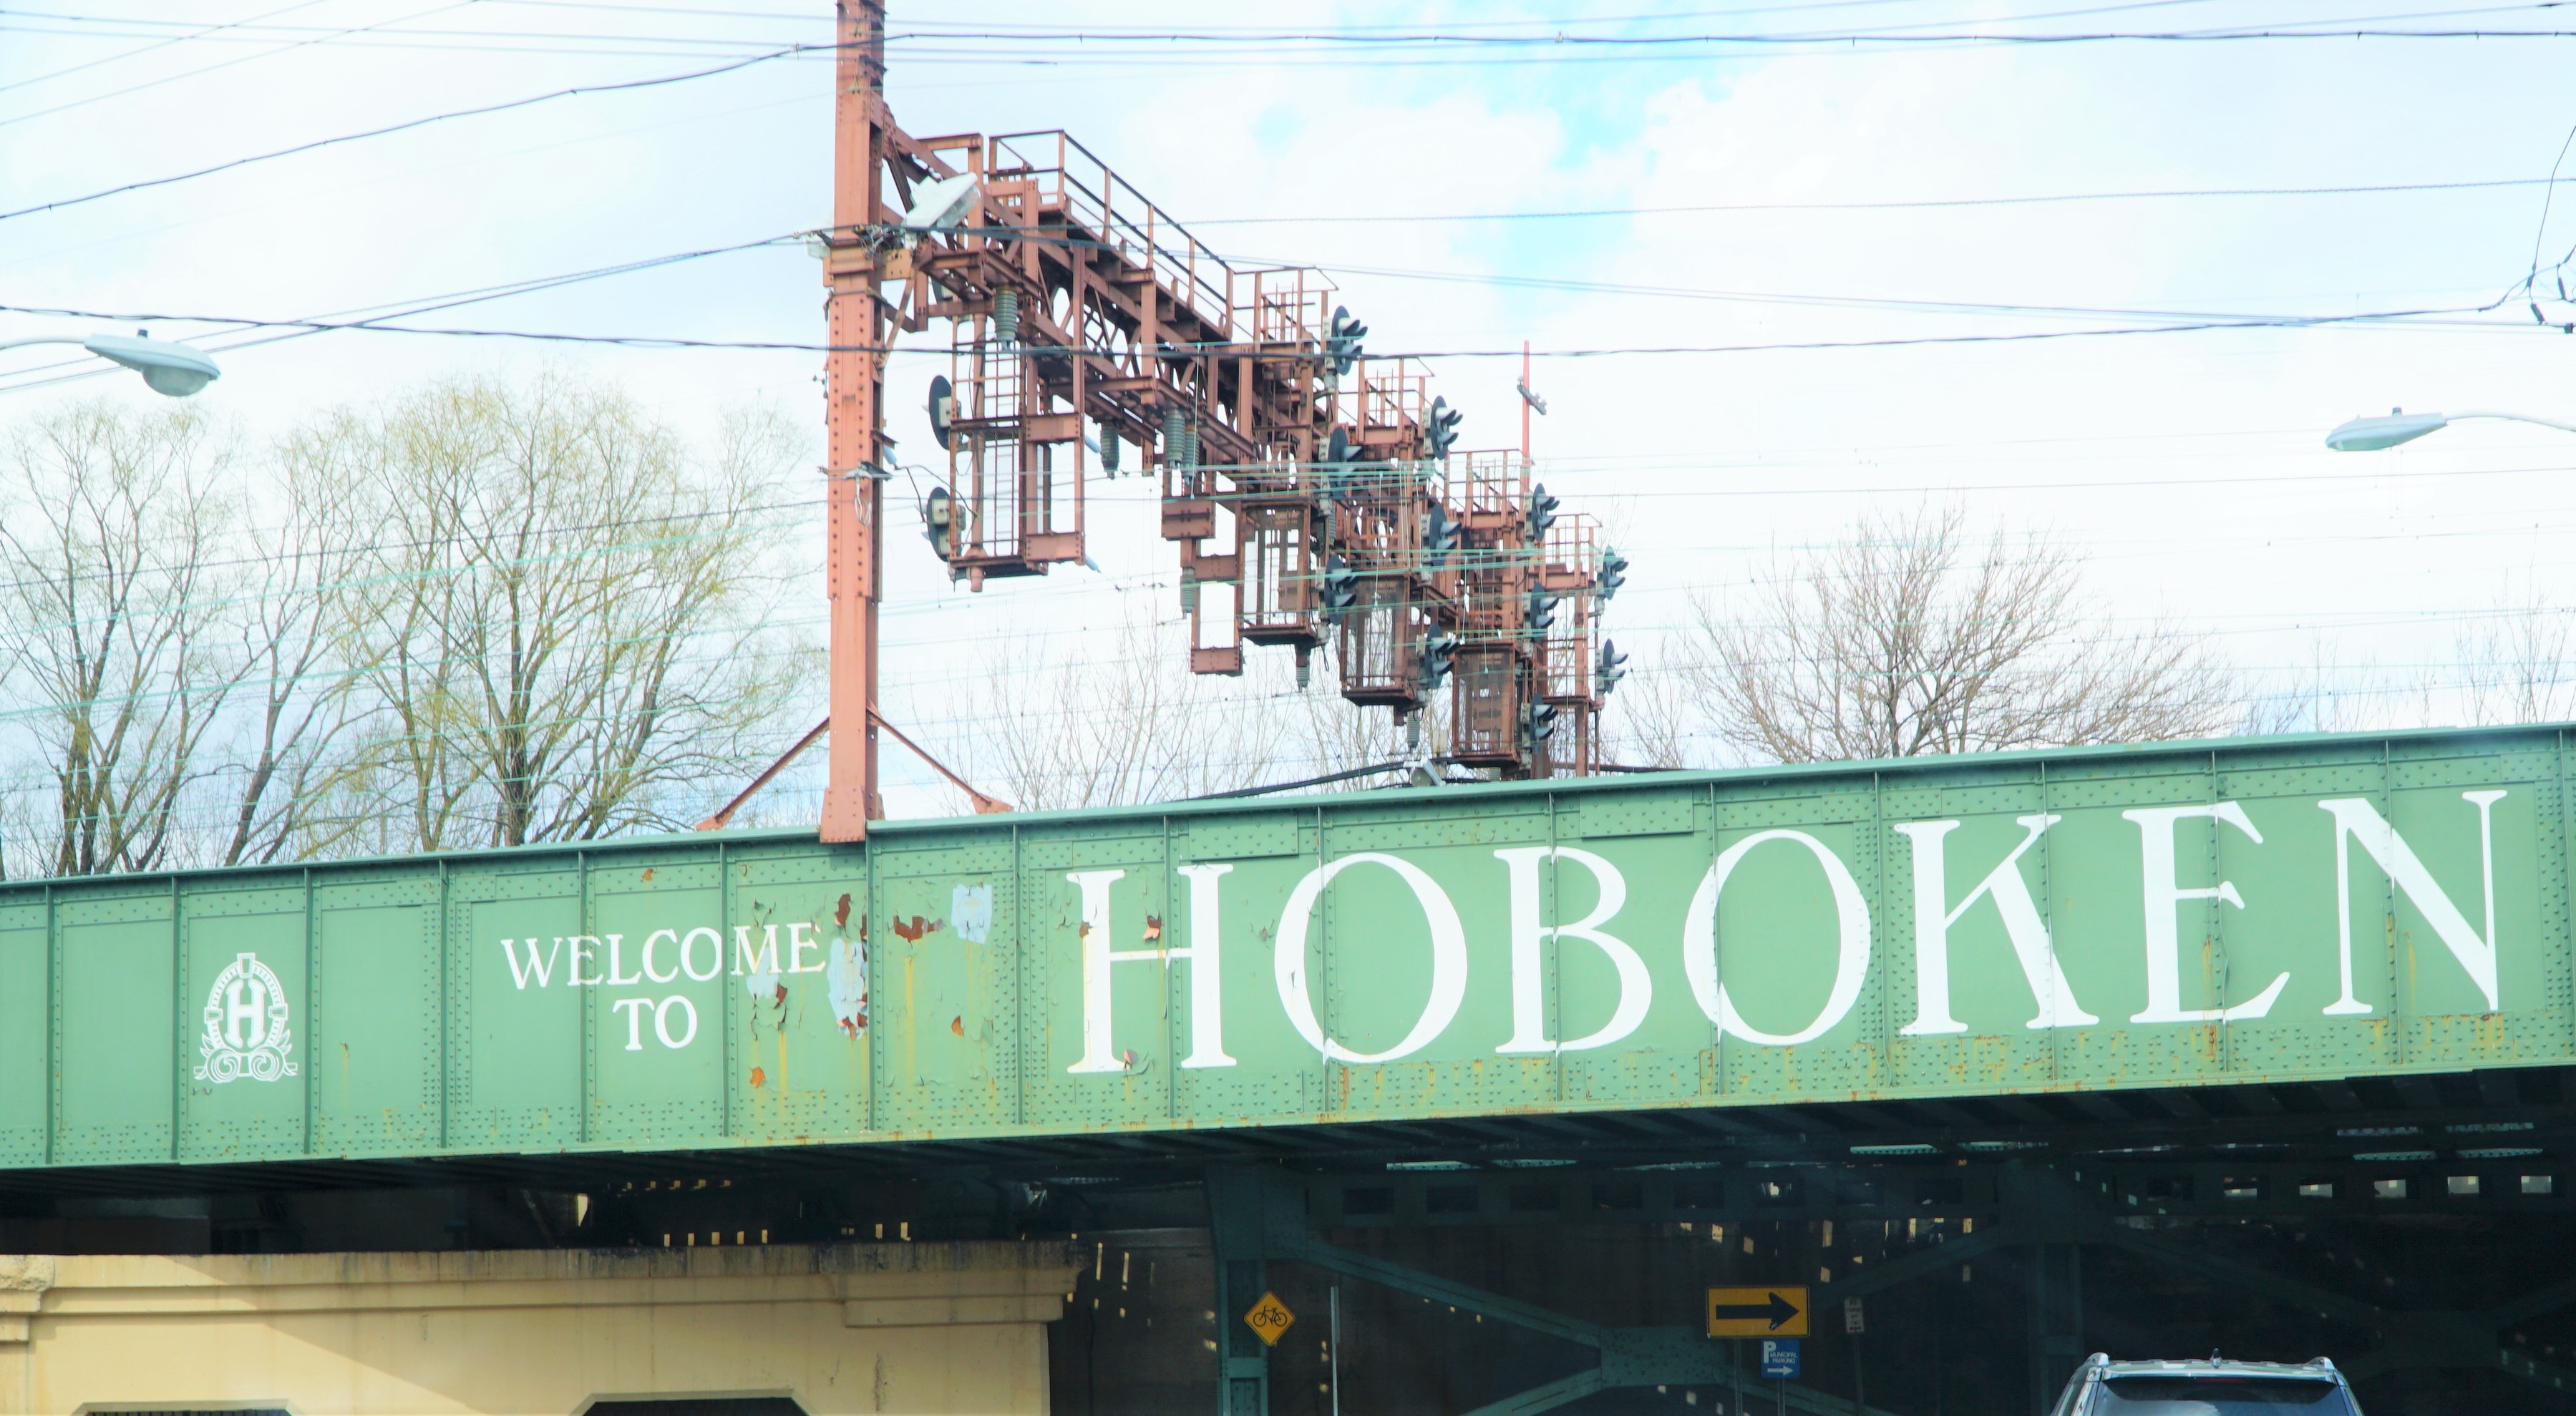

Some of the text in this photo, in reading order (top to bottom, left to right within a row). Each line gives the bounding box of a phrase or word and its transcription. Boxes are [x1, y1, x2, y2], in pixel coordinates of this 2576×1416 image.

[502, 922, 826, 990] WELCOME
[1066, 790, 2507, 1074] HOBOKEN
[225, 979, 266, 1049] H
[613, 995, 699, 1051] TO
[1764, 1340, 1777, 1364] P
